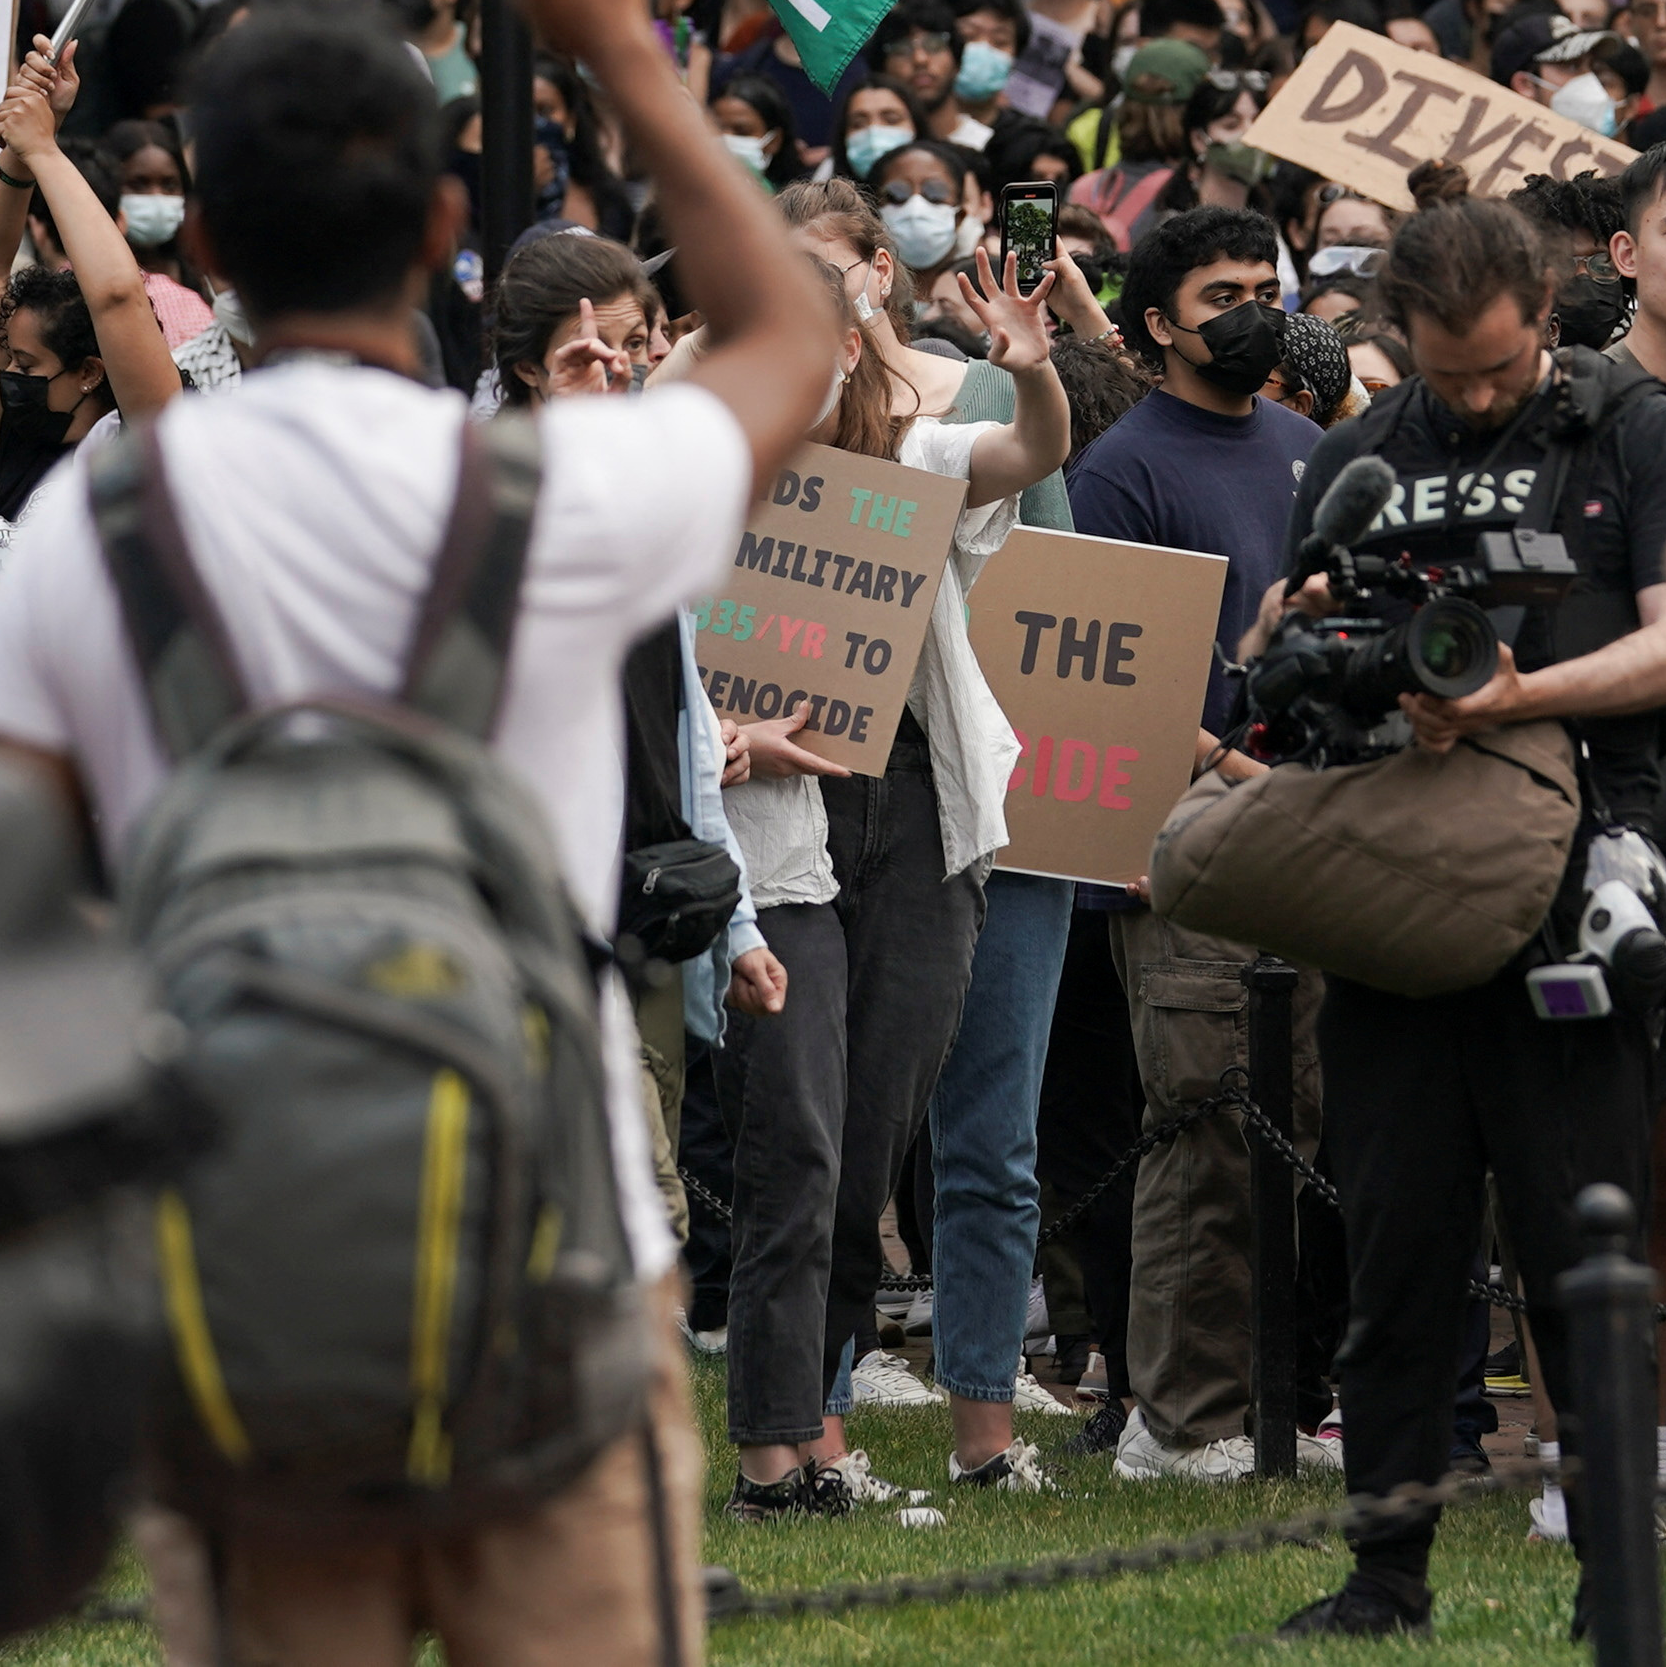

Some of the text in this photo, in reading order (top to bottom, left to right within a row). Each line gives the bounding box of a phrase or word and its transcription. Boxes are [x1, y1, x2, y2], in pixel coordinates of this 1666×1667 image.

[849, 487, 919, 538] THE
[1368, 468, 1537, 533] RESS
[734, 531, 928, 609] MILITARY
[844, 631, 893, 676] TO
[1014, 610, 1144, 687] THE
